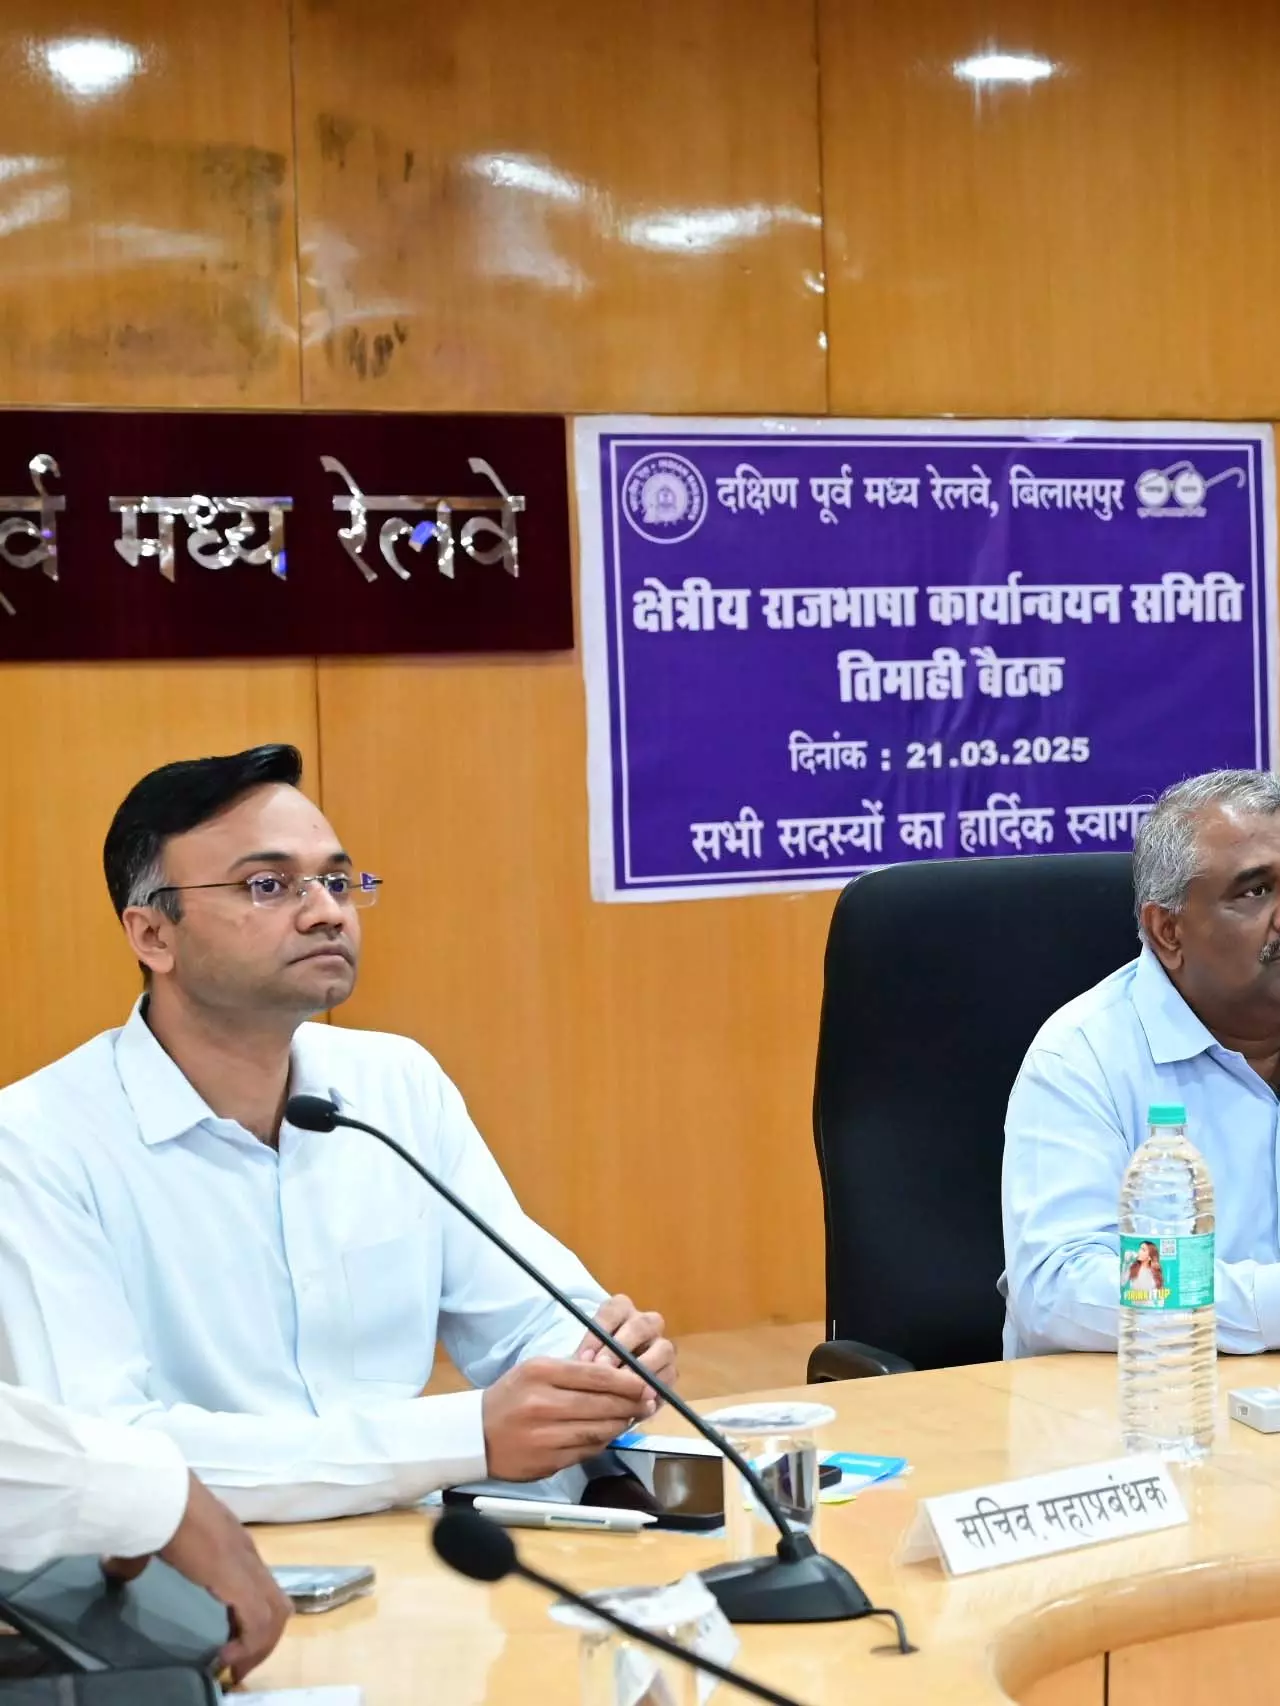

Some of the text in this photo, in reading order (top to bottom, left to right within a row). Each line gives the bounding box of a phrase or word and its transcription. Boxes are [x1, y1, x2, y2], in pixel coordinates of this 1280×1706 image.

[109, 493, 293, 583] मध्य
[320, 455, 525, 583] रेलवे
[716, 463, 799, 514] दक्षिण
[809, 463, 854, 524] पूर्व
[863, 476, 921, 509] मध्य
[926, 464, 1000, 518] रेलवे,
[1009, 463, 1125, 521] बिलासपुर
[632, 571, 1245, 633] क्षेत्रीय राजभाषा कार्यान्वयन समिति
[837, 645, 1066, 703] तिमाही बैठक
[788, 729, 868, 775] दिनांक
[905, 735, 1090, 770] 21.03.2025
[690, 792, 1156, 863] सभी सदस्यों का हार्दिक स्वाग
[1036, 1474, 1169, 1538] महाप्रबंधक
